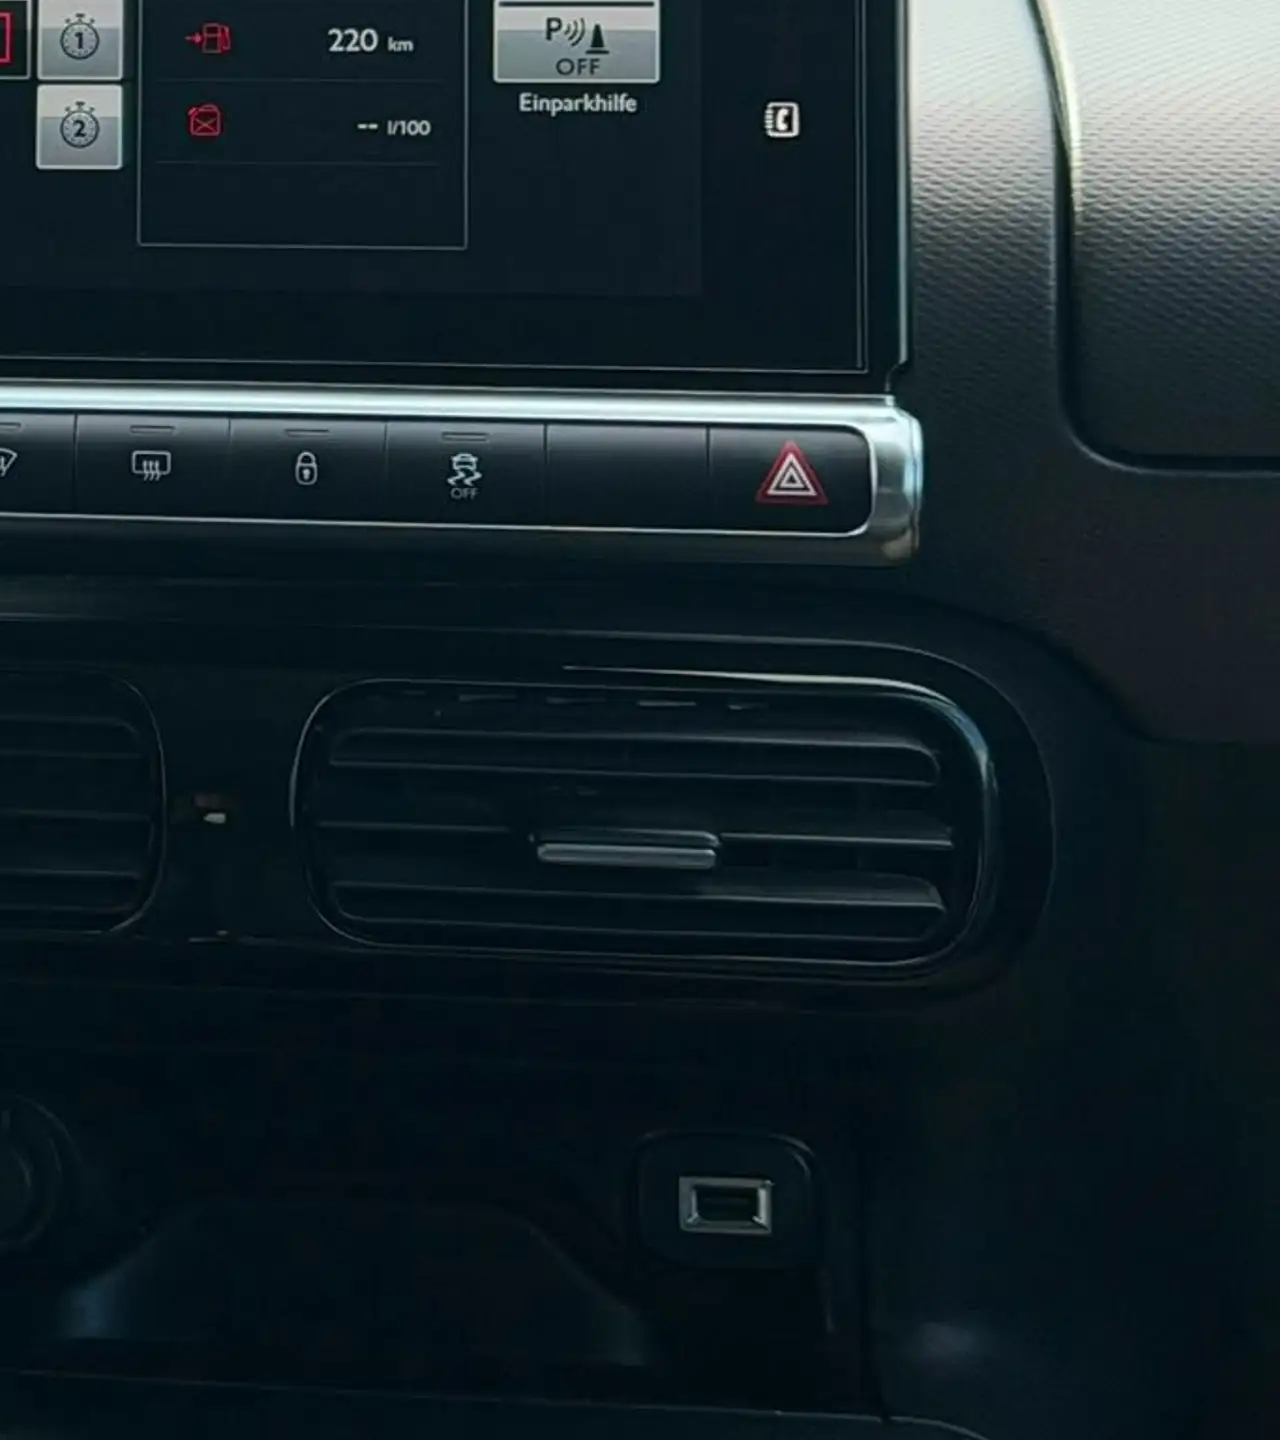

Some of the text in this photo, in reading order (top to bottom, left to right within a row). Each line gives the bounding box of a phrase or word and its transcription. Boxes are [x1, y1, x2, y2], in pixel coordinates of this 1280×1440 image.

[327, 28, 414, 53] 220 km
[555, 57, 601, 76] OFF
[518, 92, 638, 117] Einparkhilfe
